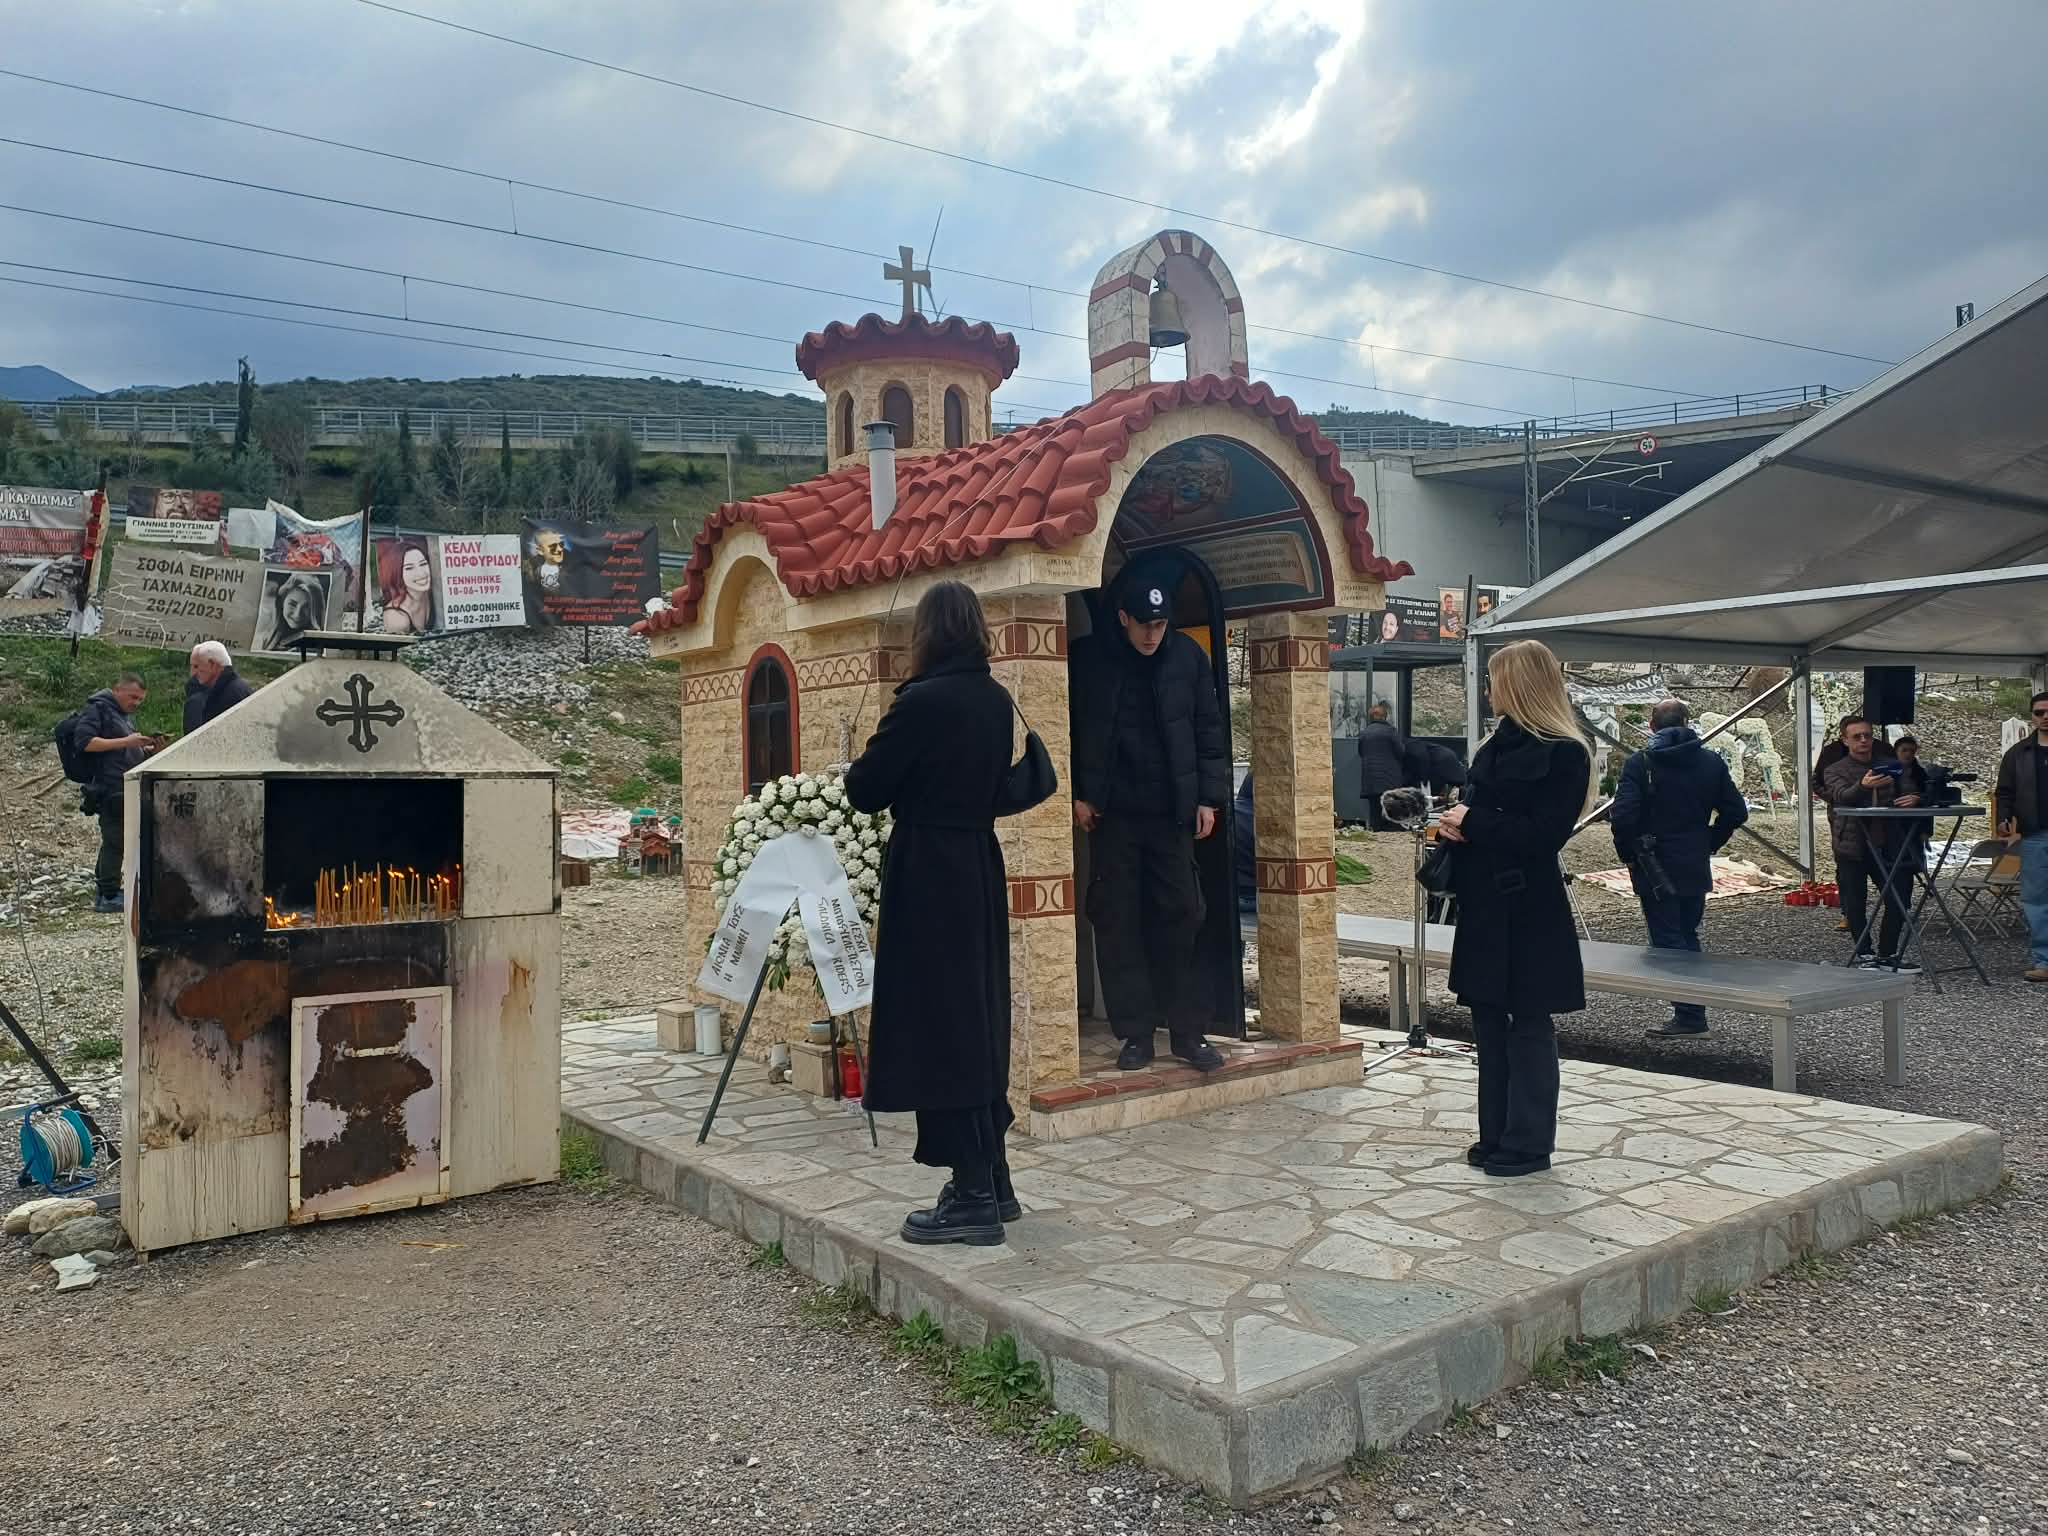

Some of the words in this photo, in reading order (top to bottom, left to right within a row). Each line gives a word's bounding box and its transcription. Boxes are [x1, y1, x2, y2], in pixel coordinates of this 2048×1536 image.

[9, 491, 49, 505] ΚΑΡΔΙΑ
[51, 494, 76, 508] ΜΑΣ
[132, 519, 168, 529] ΓΙΑΝΝΗΣ
[444, 541, 482, 554] ΚΕΛΛΥ
[445, 554, 519, 568] ΠΟΡΦΥΡΙΔΟΥ
[135, 556, 184, 576] ΣΟΦΙΑ
[189, 564, 245, 584] ΕΙΡΗΝΗ
[447, 574, 502, 586] ΓΕΝΝΗΘΗΚΕ
[142, 578, 237, 603] ΤΑΧΜΑΖΙΔΟΥ
[145, 597, 225, 620] 28/2/2023
[447, 601, 521, 614] ΔΟΛΟΦΟΝΗΘΗΚΕ
[448, 613, 501, 625] 28-02-2023
[712, 937, 730, 975] ΑΙΩΝΙΑ
[727, 902, 744, 929] ΤΟΥΣ
[833, 957, 854, 994] RIDERS
